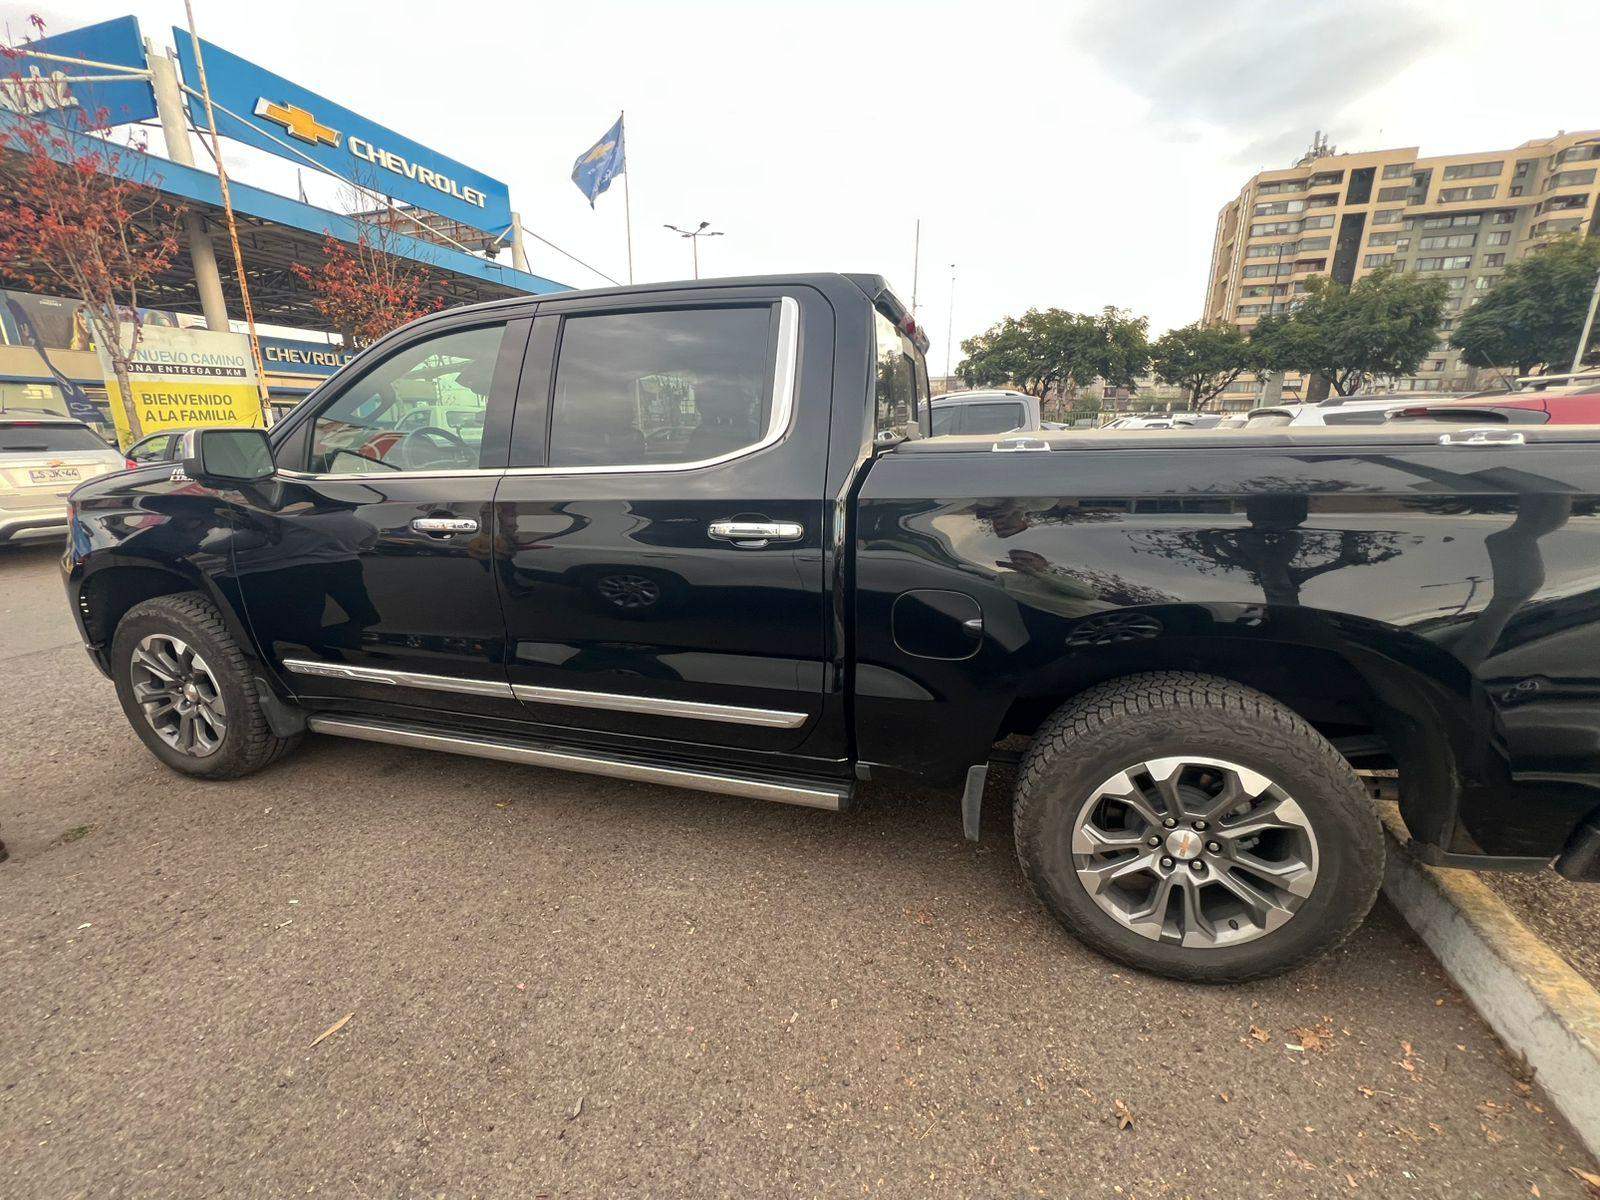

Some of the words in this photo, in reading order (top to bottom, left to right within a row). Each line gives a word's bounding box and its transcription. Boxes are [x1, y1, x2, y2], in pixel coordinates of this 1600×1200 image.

[348, 135, 487, 208] CHEVROLET
[136, 350, 188, 364] NUEVO
[190, 352, 245, 367] CAMINO
[265, 346, 355, 367] CHEVROLE
[128, 363, 153, 372] ONA
[158, 365, 211, 375] ENTREGA
[226, 368, 242, 376] KM
[141, 393, 233, 406] BIENVENIDO
[145, 409, 154, 422] A
[159, 409, 178, 422] LA
[181, 409, 237, 422] FAMILIA
